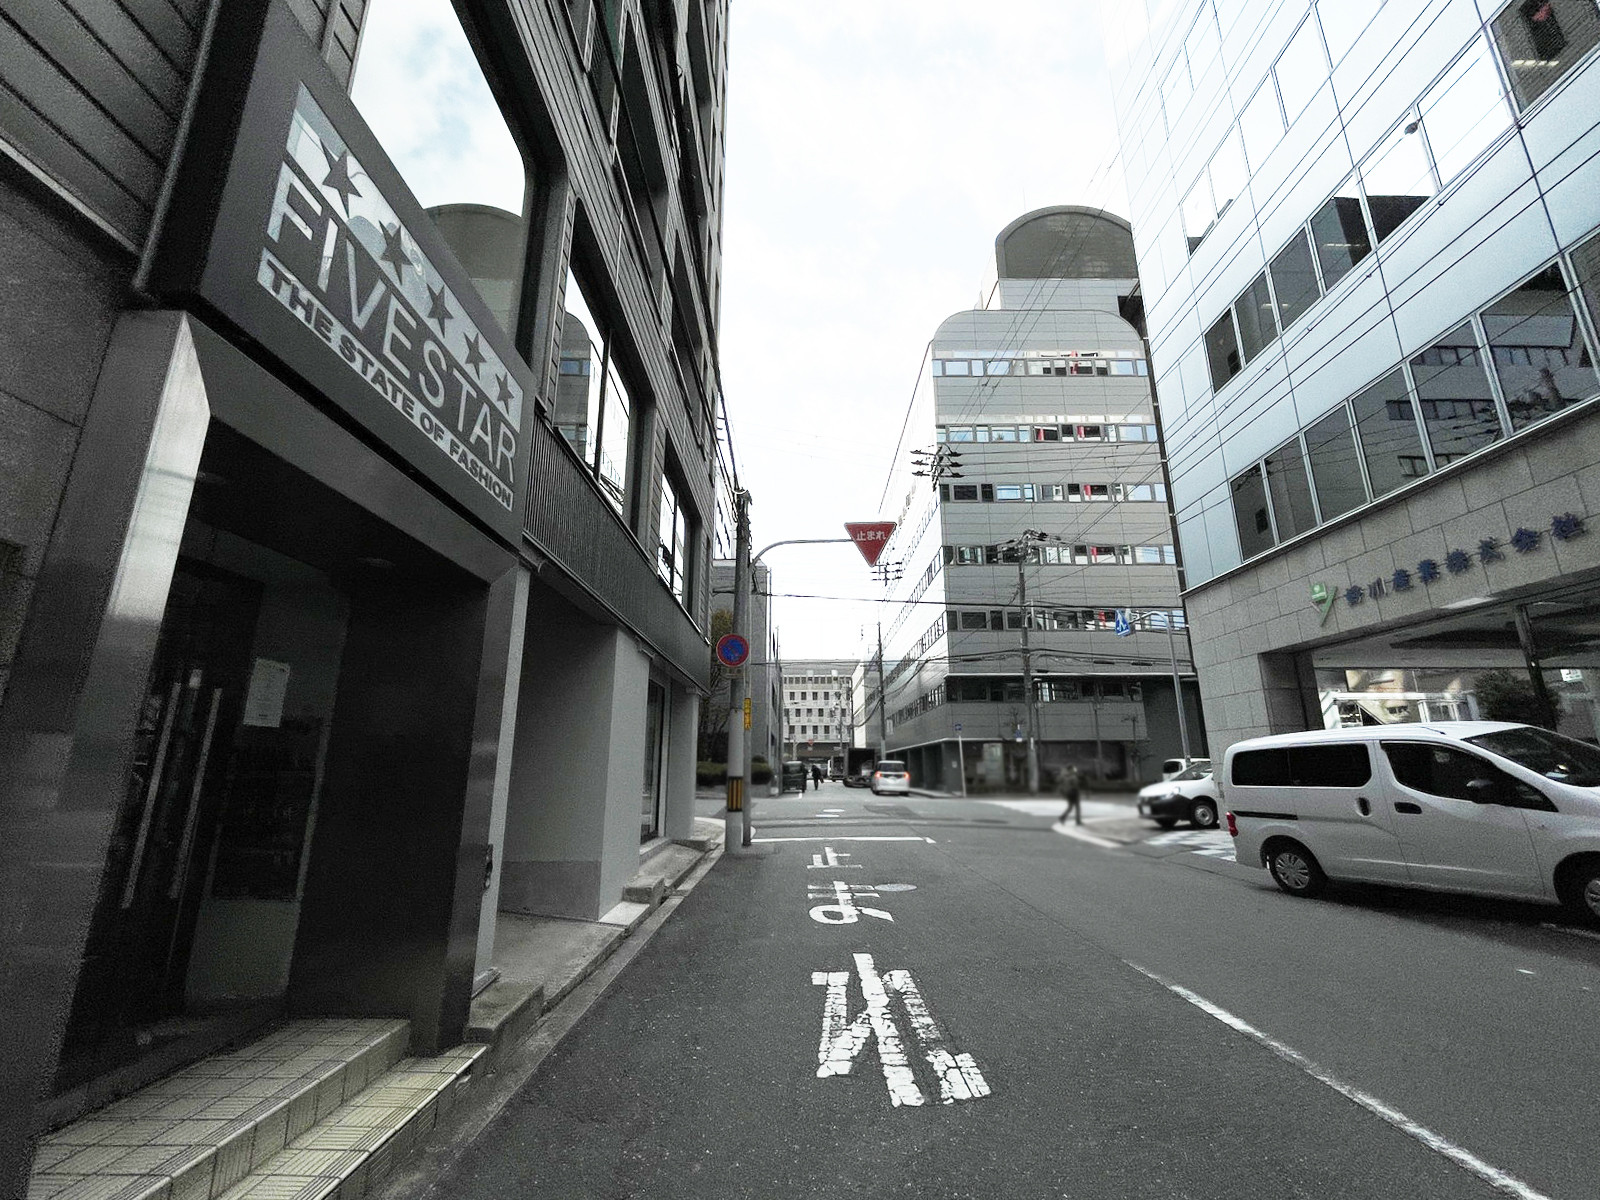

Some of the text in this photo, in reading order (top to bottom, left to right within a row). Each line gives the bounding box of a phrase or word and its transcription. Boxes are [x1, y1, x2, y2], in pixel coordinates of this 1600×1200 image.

[266, 257, 513, 506] THE STATE OF FASHION
[856, 530, 887, 541] 止まれ
